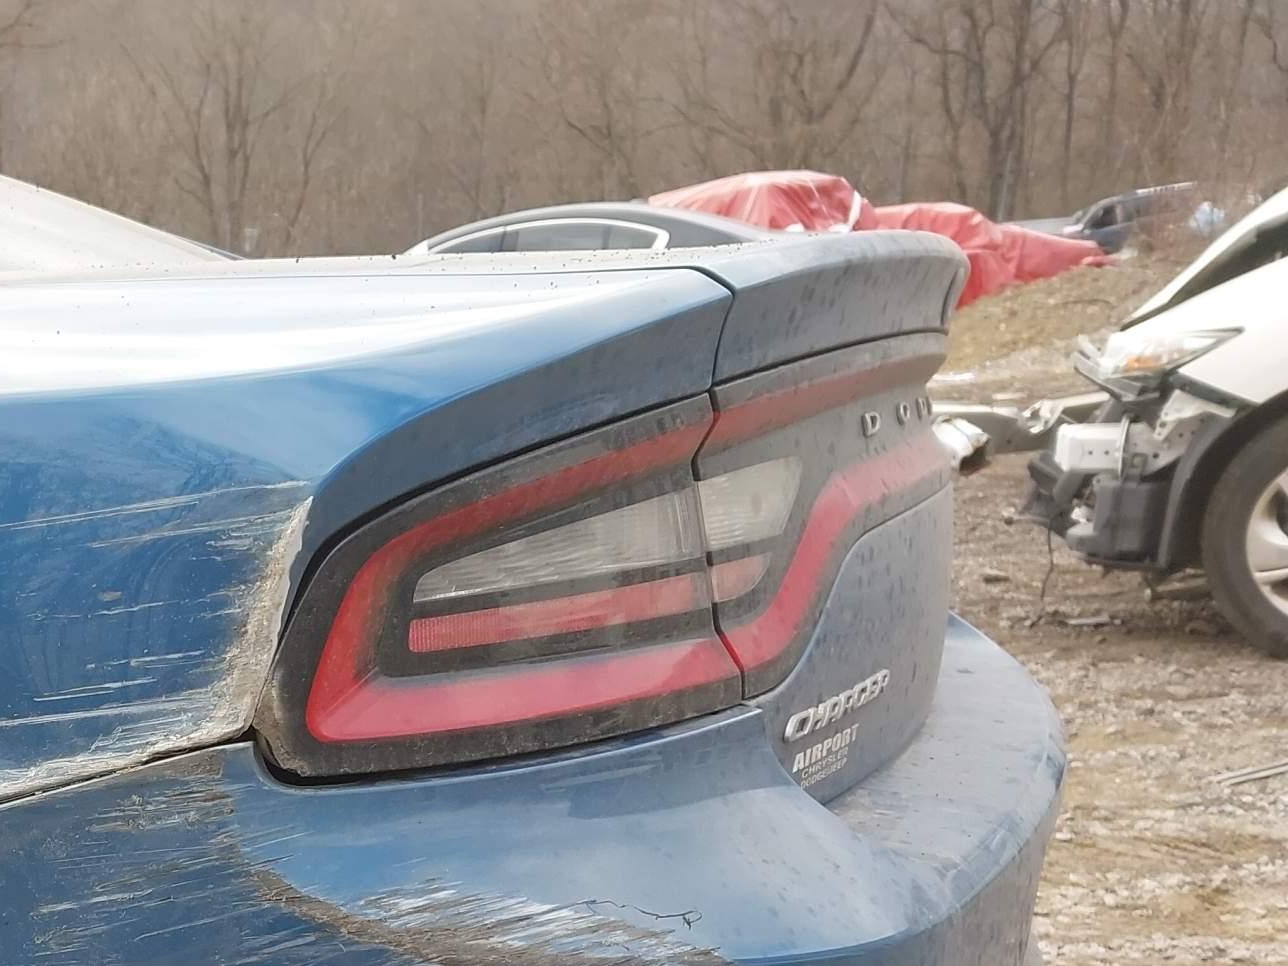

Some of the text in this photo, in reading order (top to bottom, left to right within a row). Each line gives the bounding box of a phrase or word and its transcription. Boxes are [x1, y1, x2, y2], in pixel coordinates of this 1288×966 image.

[784, 669, 890, 744] CHARGER
[792, 723, 860, 774] AIRPORT
[801, 746, 849, 778] CHRYSLER
